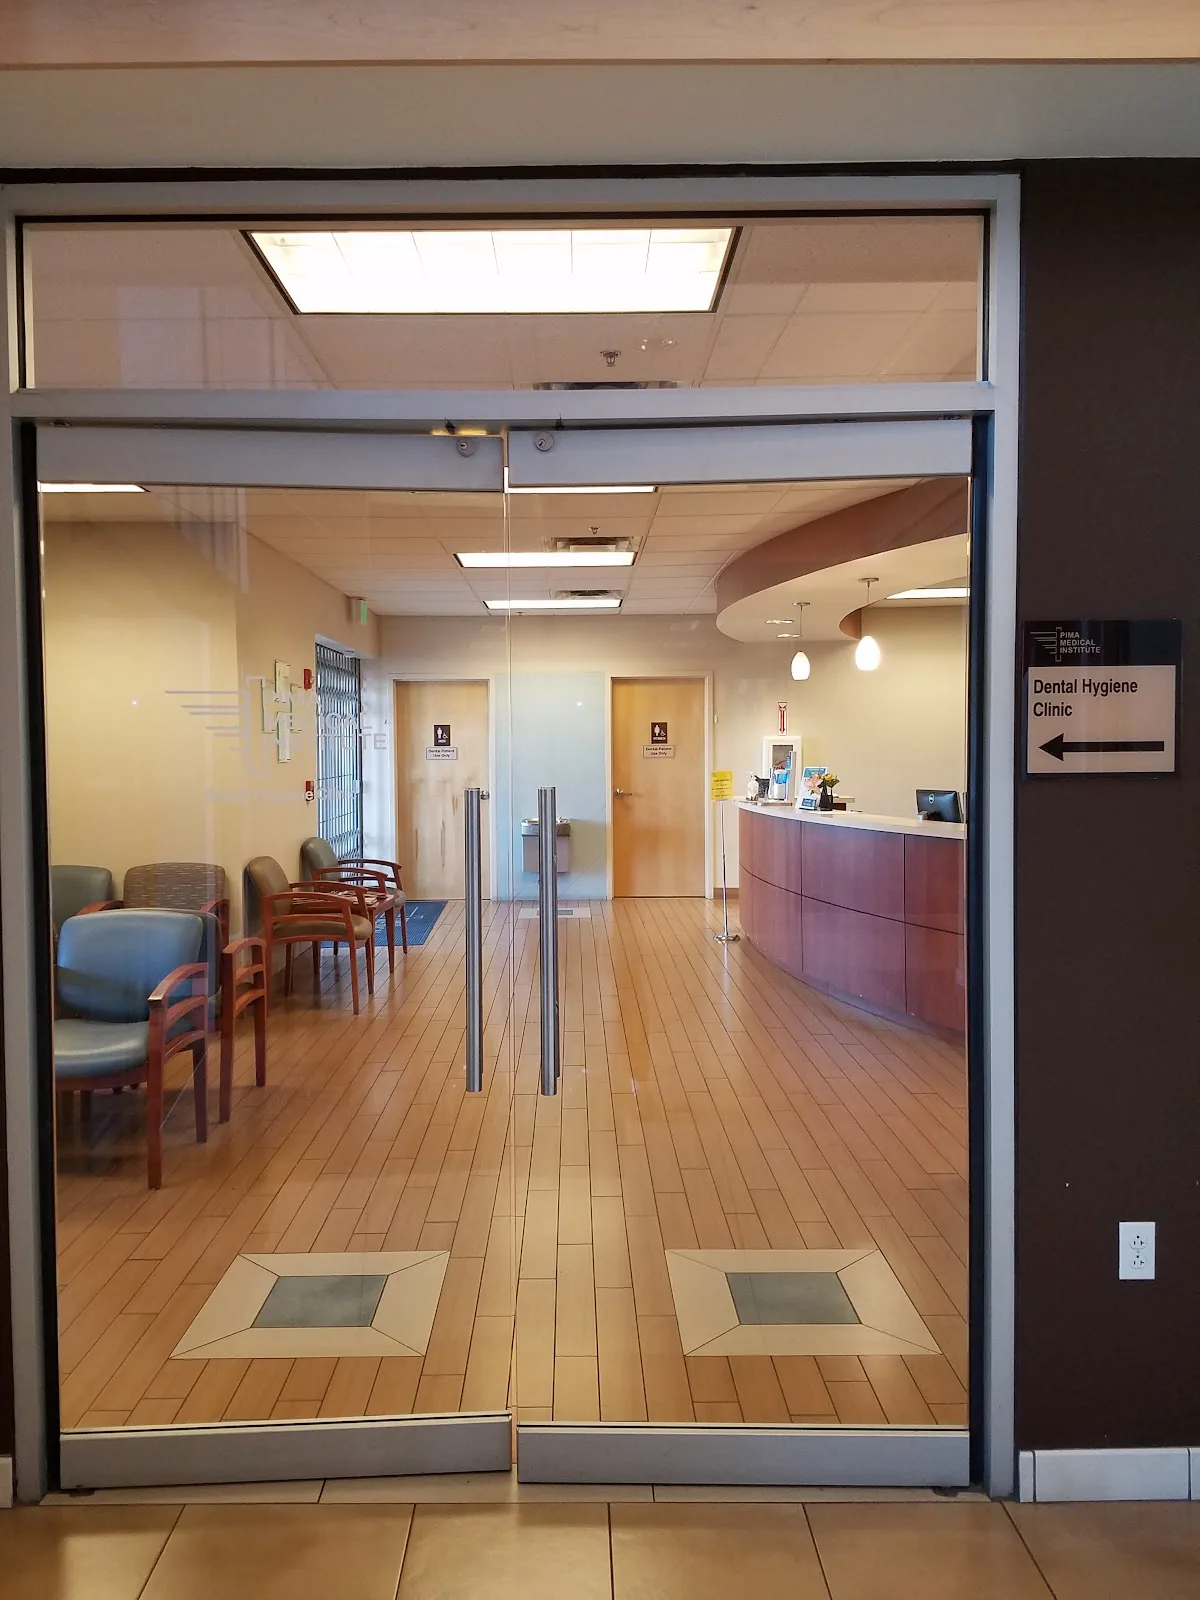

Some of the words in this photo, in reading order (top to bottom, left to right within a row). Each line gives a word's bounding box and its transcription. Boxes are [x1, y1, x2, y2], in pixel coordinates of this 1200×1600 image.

[1033, 679, 1077, 694] Dental
[1082, 678, 1138, 697] Hygiene
[1033, 702, 1073, 717] Clinic
